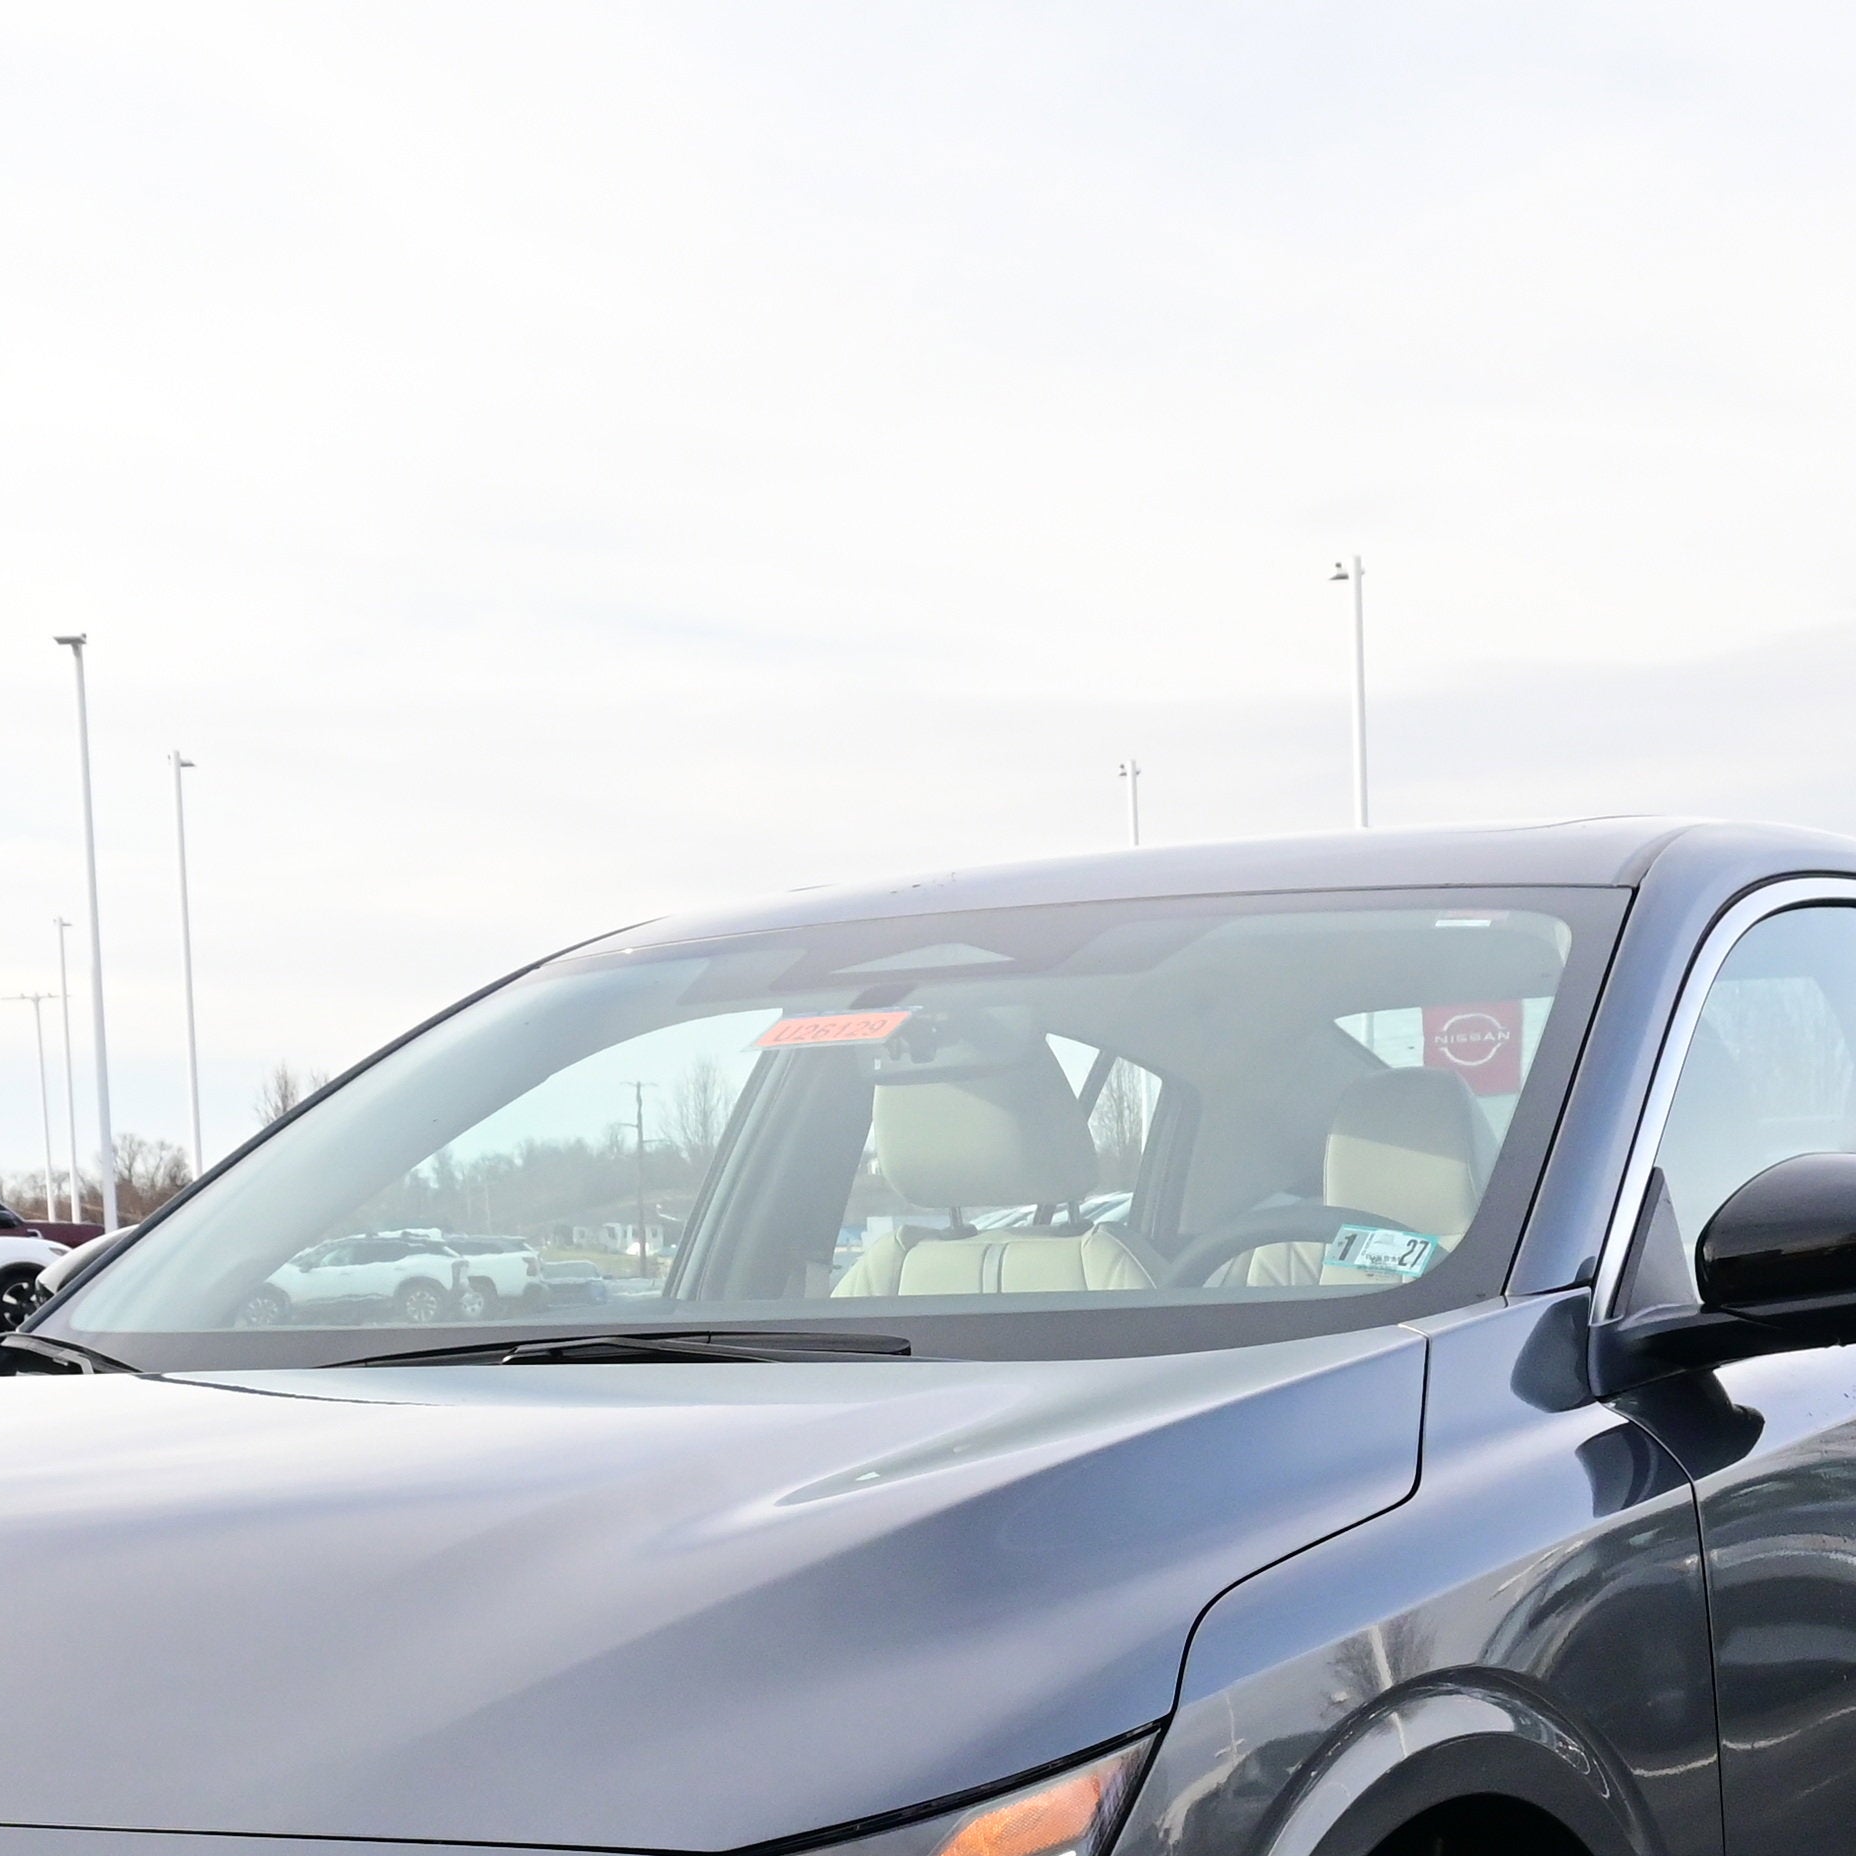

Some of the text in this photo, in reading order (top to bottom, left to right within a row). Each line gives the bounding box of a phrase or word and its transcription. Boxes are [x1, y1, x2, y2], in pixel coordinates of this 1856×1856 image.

[772, 1019, 889, 1043] U26129
[1434, 1030, 1511, 1044] NISSAN
[1338, 1233, 1358, 1261] 1
[1398, 1238, 1430, 1270] 27
